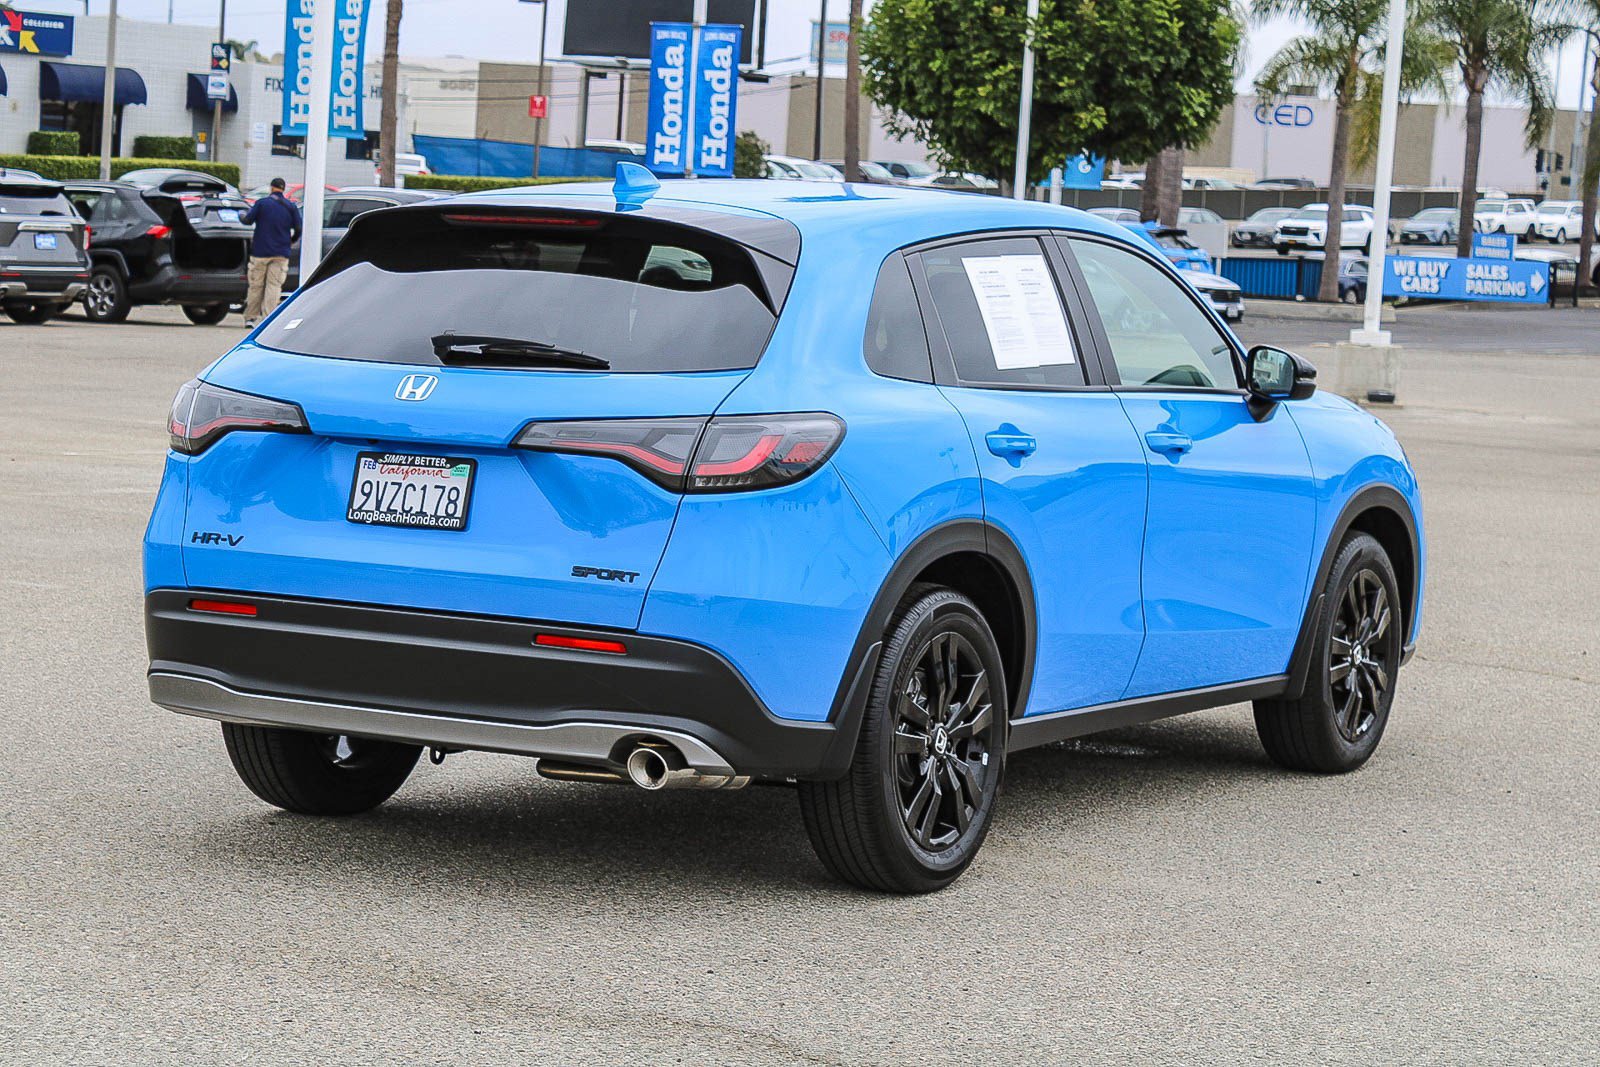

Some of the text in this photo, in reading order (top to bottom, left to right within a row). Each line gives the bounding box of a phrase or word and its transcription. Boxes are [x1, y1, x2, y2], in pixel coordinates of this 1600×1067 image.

[653, 43, 685, 166] Honda
[701, 45, 733, 169] Honda
[1255, 103, 1313, 126] CED
[1393, 260, 1449, 278] WE BUY
[1466, 264, 1509, 280] SALES
[1401, 276, 1440, 293] CARS
[1466, 280, 1527, 296] PARKING
[363, 460, 377, 470] FEB
[382, 454, 415, 465] SIMPLY
[379, 464, 450, 480] California
[356, 480, 461, 517] 9VZC178
[348, 508, 460, 527] LongBeachHonda.com
[191, 531, 244, 546] HR-V
[571, 566, 640, 583] SPORT
